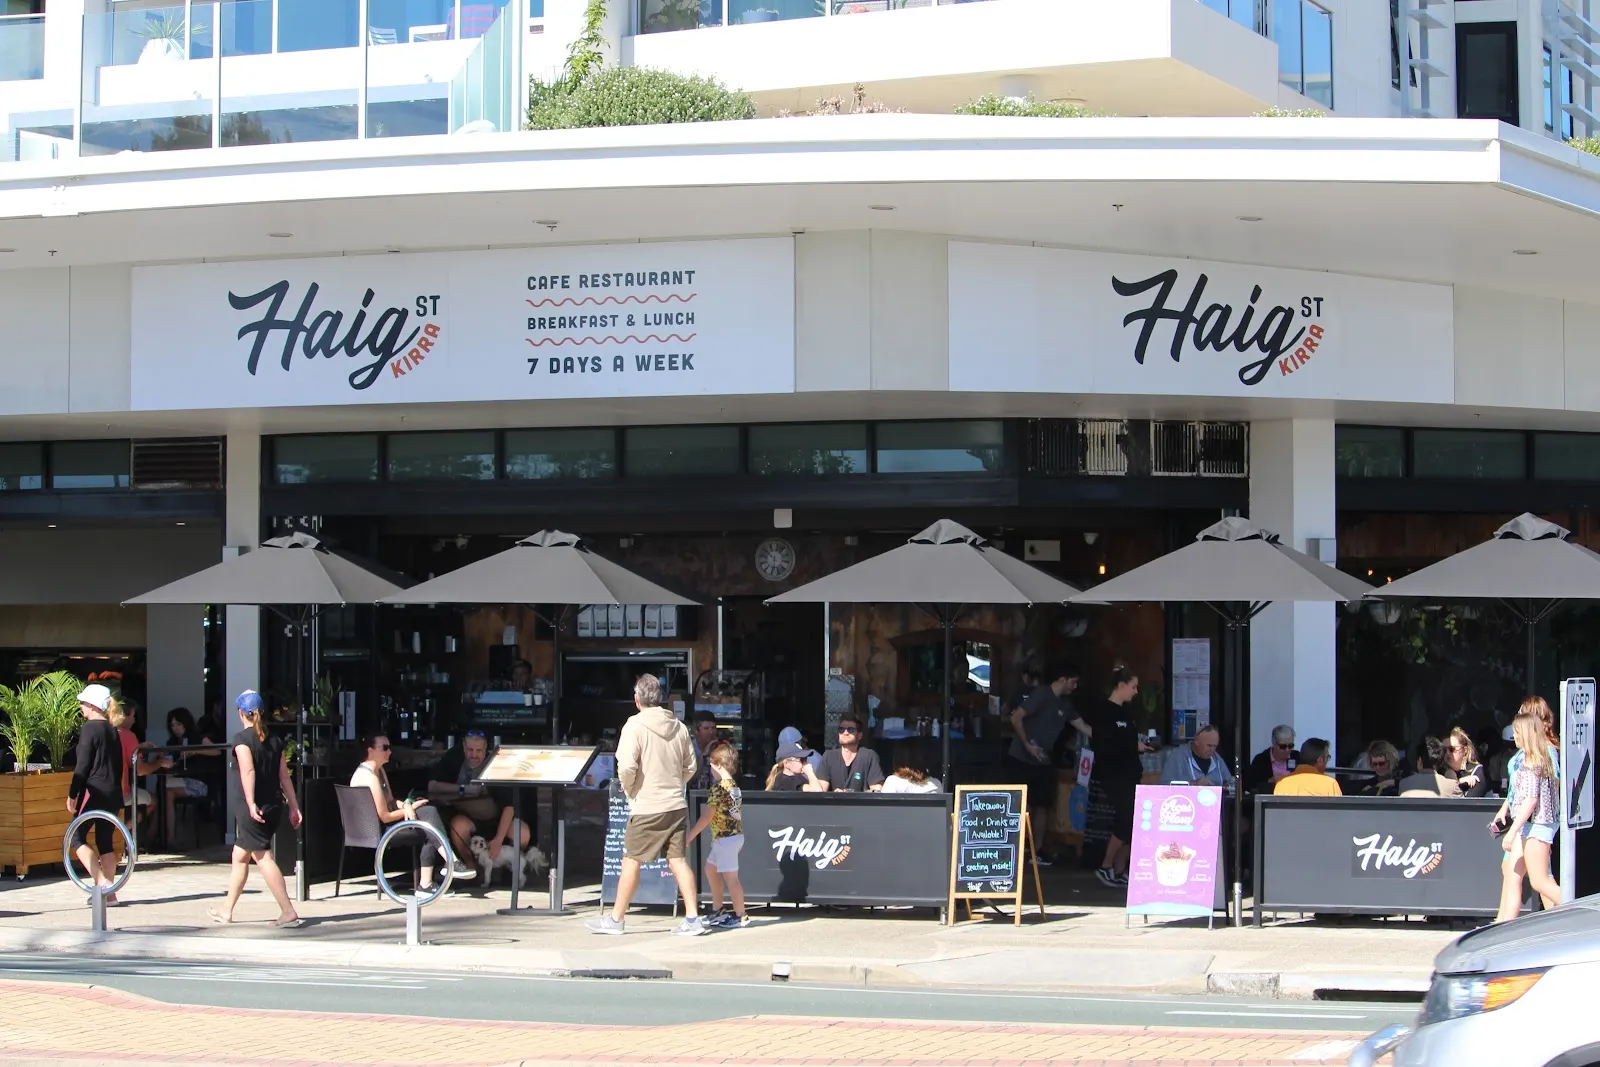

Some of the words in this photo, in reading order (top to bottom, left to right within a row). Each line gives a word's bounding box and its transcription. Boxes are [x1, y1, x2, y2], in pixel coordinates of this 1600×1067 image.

[527, 275, 570, 291] CAFE
[579, 270, 696, 288] RESTAURANT
[527, 314, 619, 330] BREAKFAST
[626, 313, 636, 327] &
[644, 312, 695, 326] LUNCH
[1111, 269, 1306, 386] Haig
[1301, 296, 1324, 318] ST
[228, 280, 420, 390] Haig
[415, 295, 441, 317] ST
[390, 323, 441, 379] KIRRA
[1278, 324, 1325, 377] KIRRA
[527, 358, 539, 375] 7
[549, 356, 602, 374] DAYS
[612, 355, 624, 372] A
[635, 353, 695, 372] WEEK
[1571, 693, 1590, 715] KEEP
[1571, 723, 1589, 745] LEFT
[969, 797, 1006, 814] Takeaway
[961, 815, 978, 827] Food
[986, 817, 1008, 827] Drinks
[971, 829, 1003, 839] Available!
[768, 826, 844, 869] Haig
[840, 835, 851, 845] ST
[972, 849, 999, 859] Limited
[1352, 833, 1435, 879] Haig
[1430, 842, 1443, 853] ST
[966, 863, 989, 874] seating
[991, 861, 1011, 870] inside!
[1420, 853, 1443, 875] KIRRA
